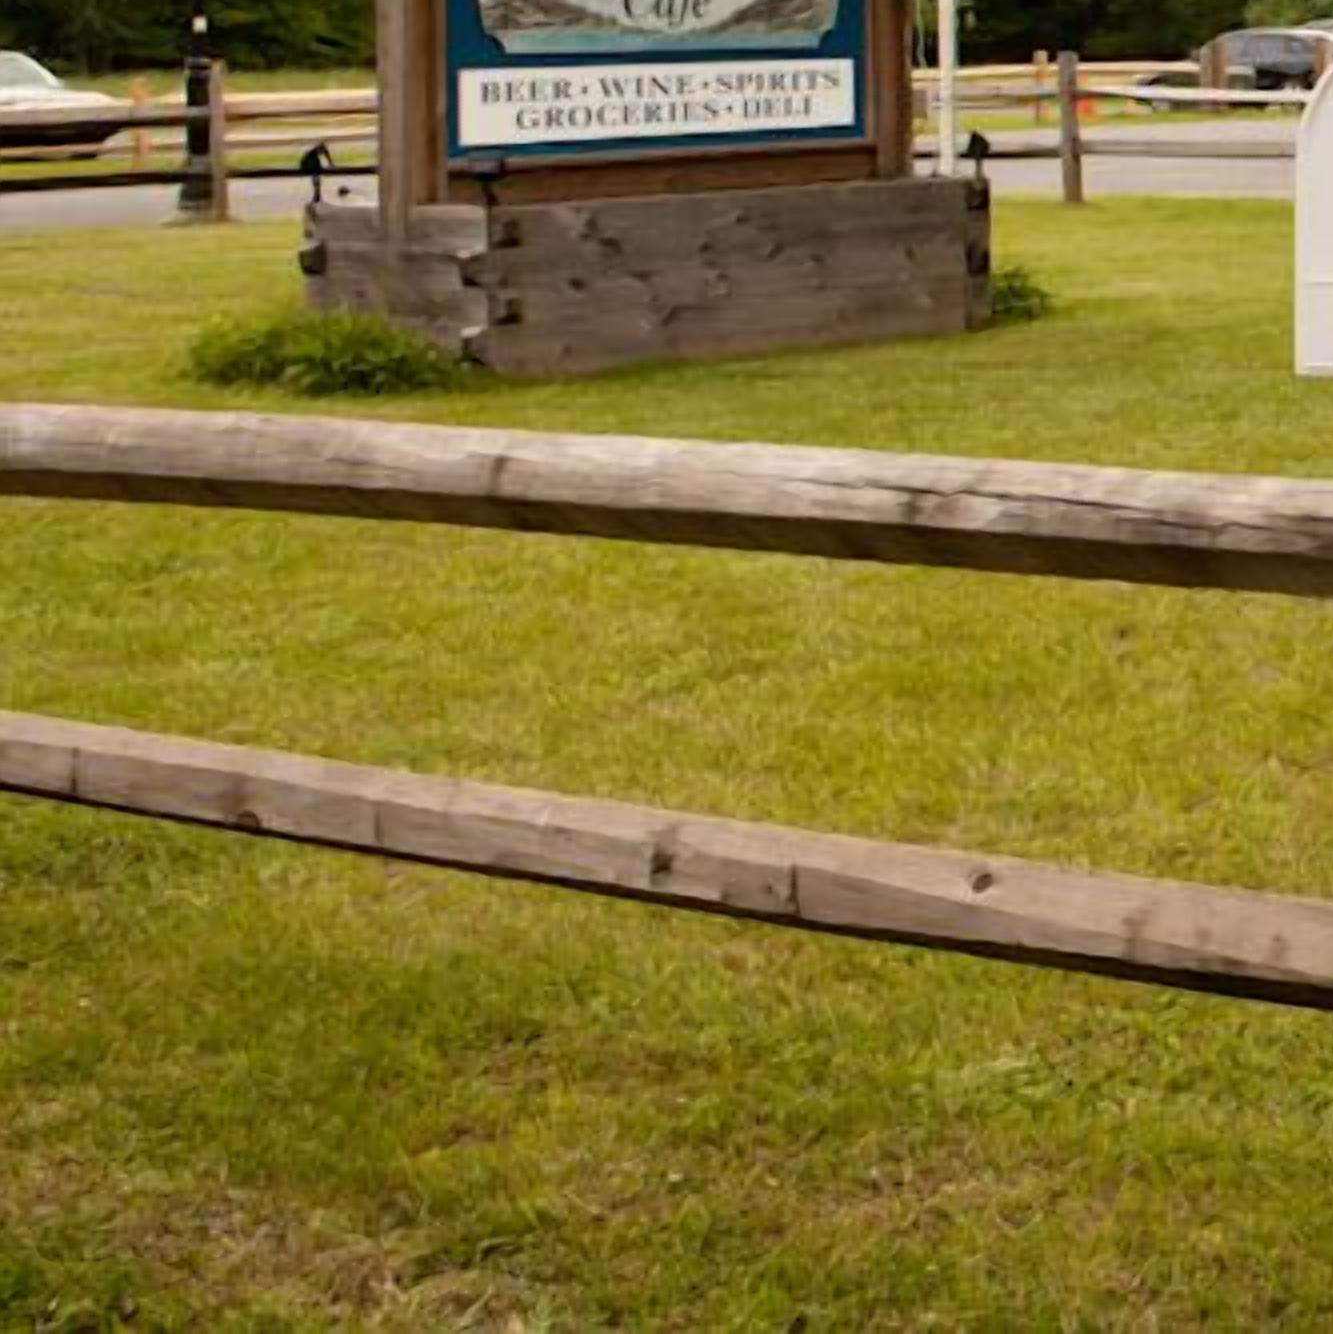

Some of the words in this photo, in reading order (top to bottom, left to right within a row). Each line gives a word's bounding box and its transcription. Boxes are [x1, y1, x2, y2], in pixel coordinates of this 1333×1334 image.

[480, 77, 572, 104] BEER
[600, 73, 697, 99] WINE
[714, 69, 840, 93] SPIRITS
[515, 100, 719, 130] GROCERIES
[743, 97, 814, 119] DELI
